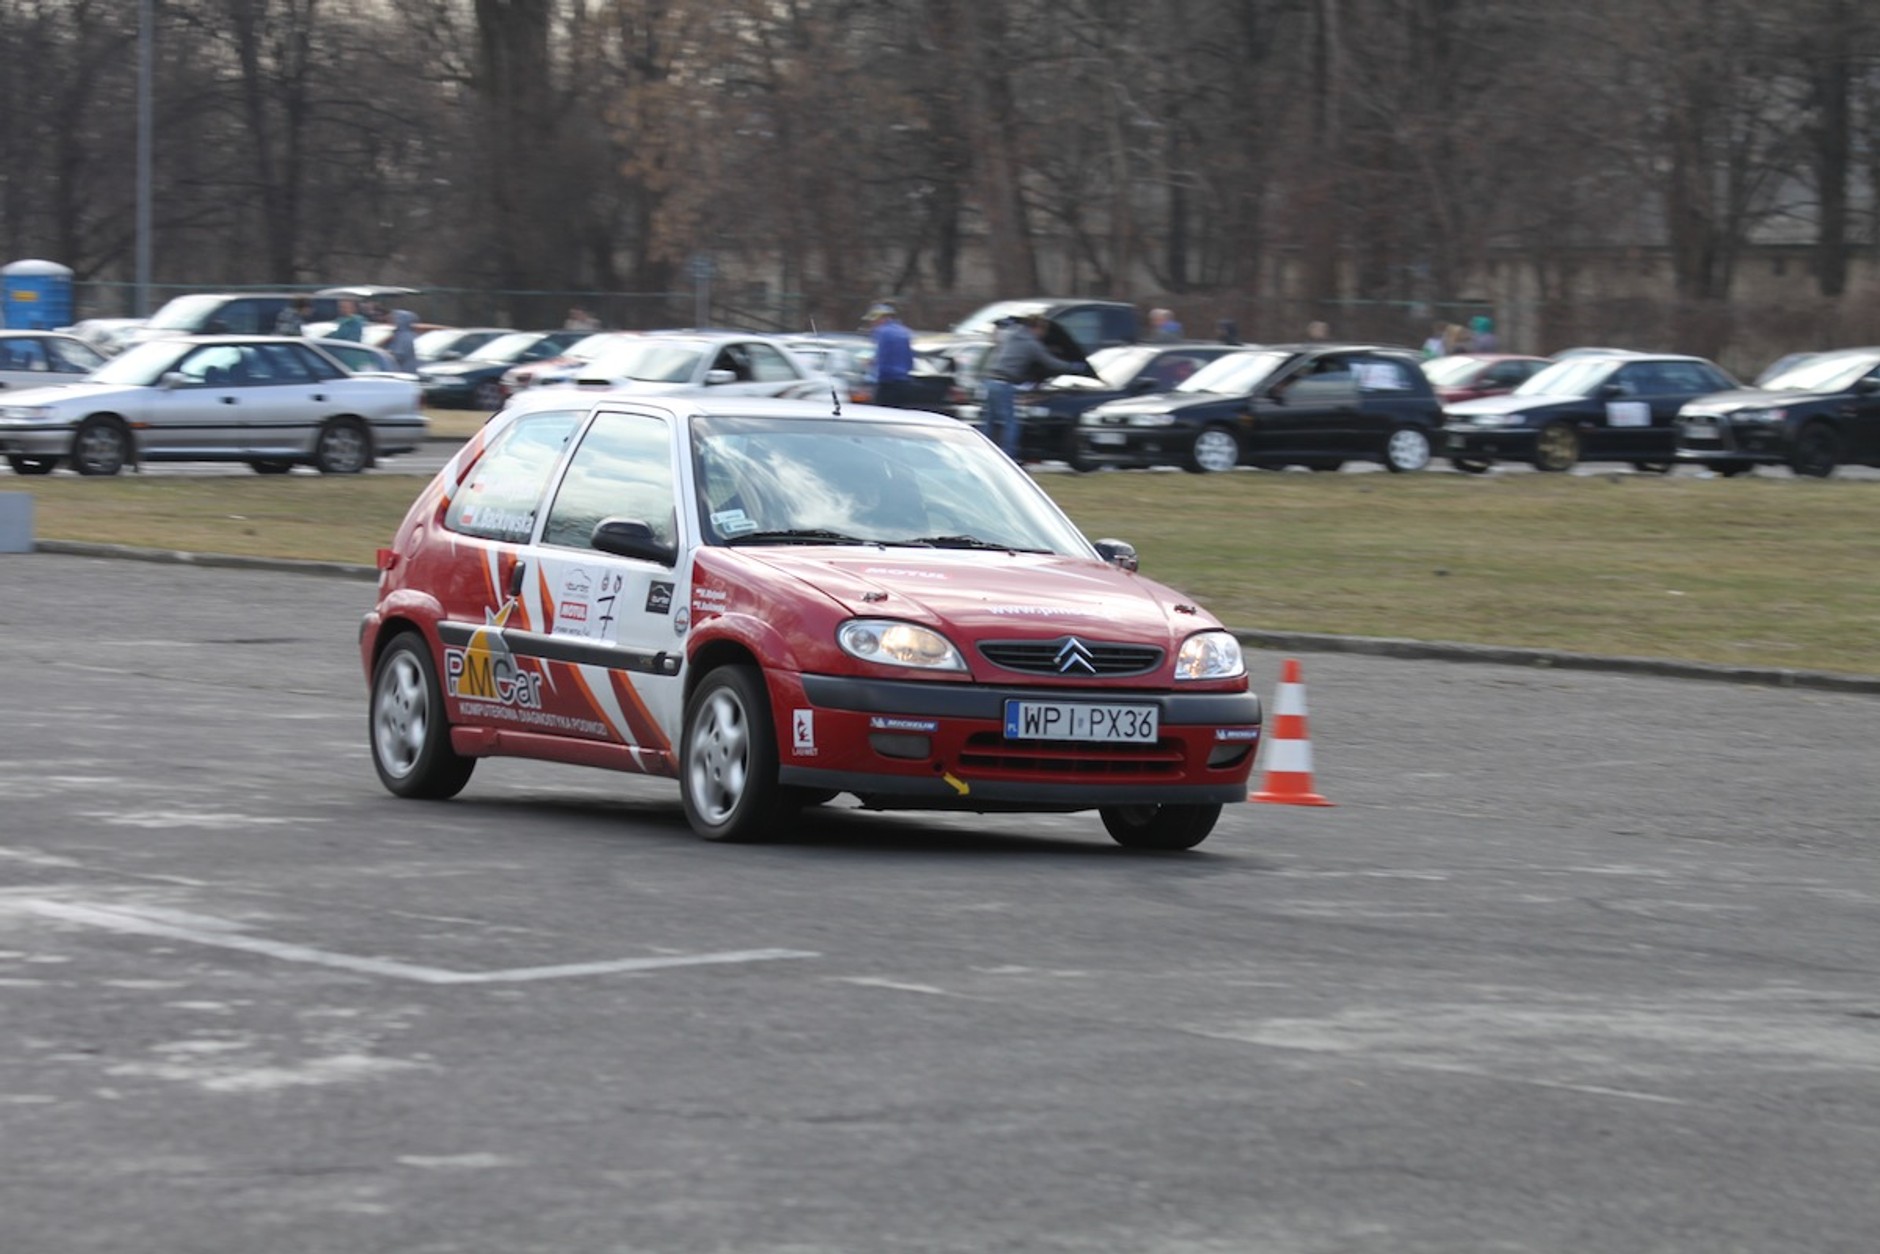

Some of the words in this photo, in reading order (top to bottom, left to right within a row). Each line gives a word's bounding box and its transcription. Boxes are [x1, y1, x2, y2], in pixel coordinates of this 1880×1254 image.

[865, 567, 948, 580] MOTUL
[597, 595, 616, 639] 7
[886, 719, 936, 730] MICHELIN
[1023, 706, 1075, 736] WPI
[1088, 708, 1154, 738] PX36
[1226, 729, 1258, 739] MICHELIN
